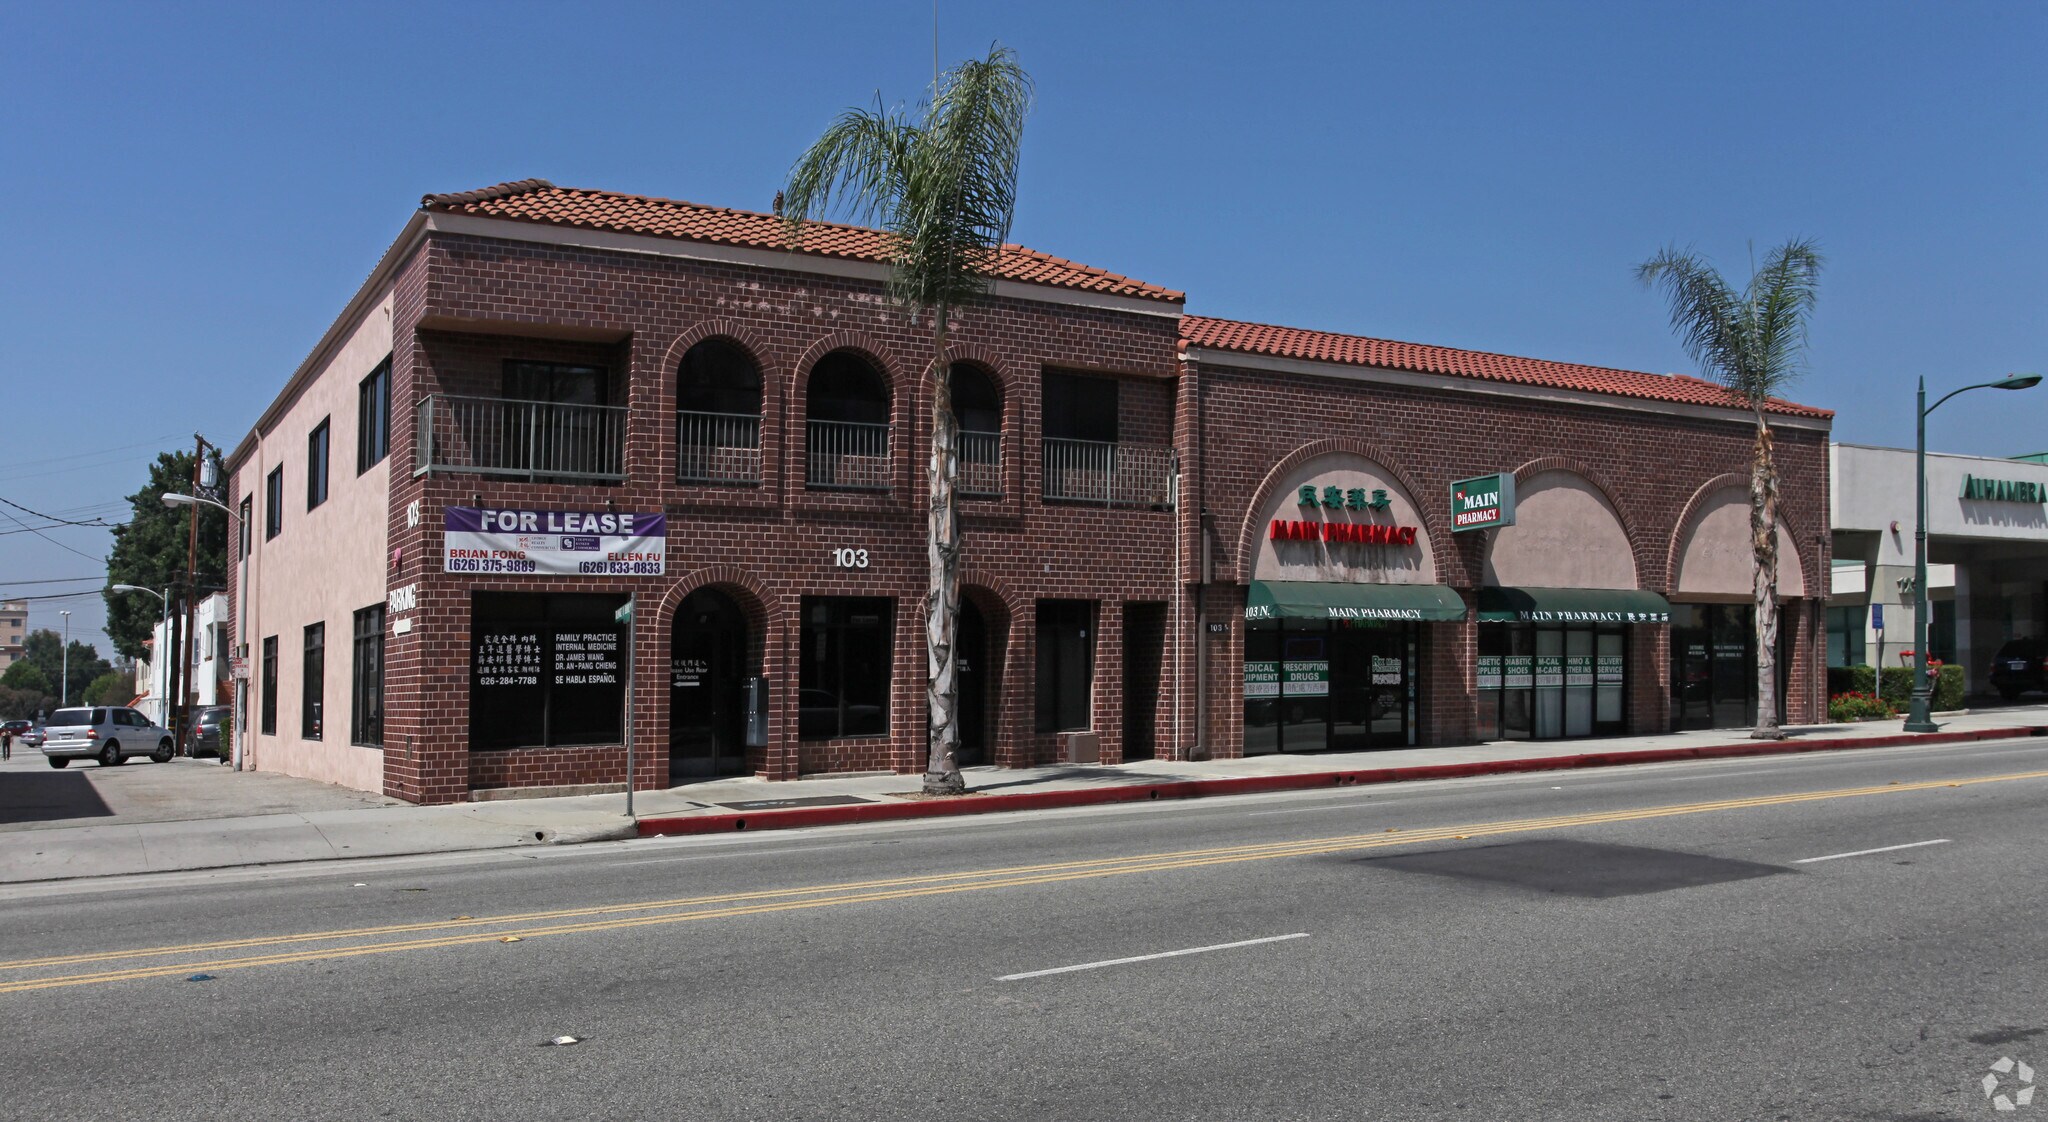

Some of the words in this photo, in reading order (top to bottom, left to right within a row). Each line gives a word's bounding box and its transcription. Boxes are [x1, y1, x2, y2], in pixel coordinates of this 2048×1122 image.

[1959, 473, 2047, 503] ALHAMBRA
[1464, 491, 1498, 509] MAIN
[407, 500, 419, 529] 103
[1457, 509, 1497, 525] PHARMACY
[481, 510, 538, 532] FOR
[547, 512, 634, 534] LEASE
[1270, 520, 1319, 541] MAIN
[1323, 522, 1417, 545] PHARMACY
[450, 549, 488, 558] BRIAN
[492, 550, 526, 559] FONG
[607, 552, 643, 561] ELLEN
[646, 553, 661, 561] FU
[832, 547, 869, 568] 103
[449, 558, 479, 571] (626)
[482, 560, 536, 572] 375-9889
[579, 561, 607, 574] (626)
[609, 562, 660, 574] 833-0833
[389, 583, 416, 614] PARKING
[1245, 606, 1258, 618] 103
[1259, 605, 1270, 616] N.
[1328, 607, 1359, 617] MAIN
[1360, 608, 1421, 618] PHARMACY
[1520, 611, 1552, 620] MAIN
[1557, 611, 1621, 621] PHARMACY
[484, 634, 517, 644] 家庭全科
[566, 653, 585, 661] JAMES
[1504, 658, 1532, 666] DIABETIC
[1538, 657, 1559, 665] M-CAL
[1567, 657, 1583, 665] HMO
[1584, 657, 1590, 665] &
[555, 662, 565, 670] DR.
[566, 662, 593, 670] AN-PANG
[595, 661, 617, 669] CHIENG
[1244, 664, 1275, 672] EDICAL
[1508, 666, 1529, 674] SHOES
[1535, 666, 1562, 674] M-CARE
[1597, 665, 1623, 673] SERVICE
[480, 677, 537, 685] 626-284-7788
[555, 675, 564, 684] SE
[566, 675, 586, 683] HABLA
[588, 672, 616, 683] ESPAÑOL
[1290, 673, 1319, 681] DRUGS
